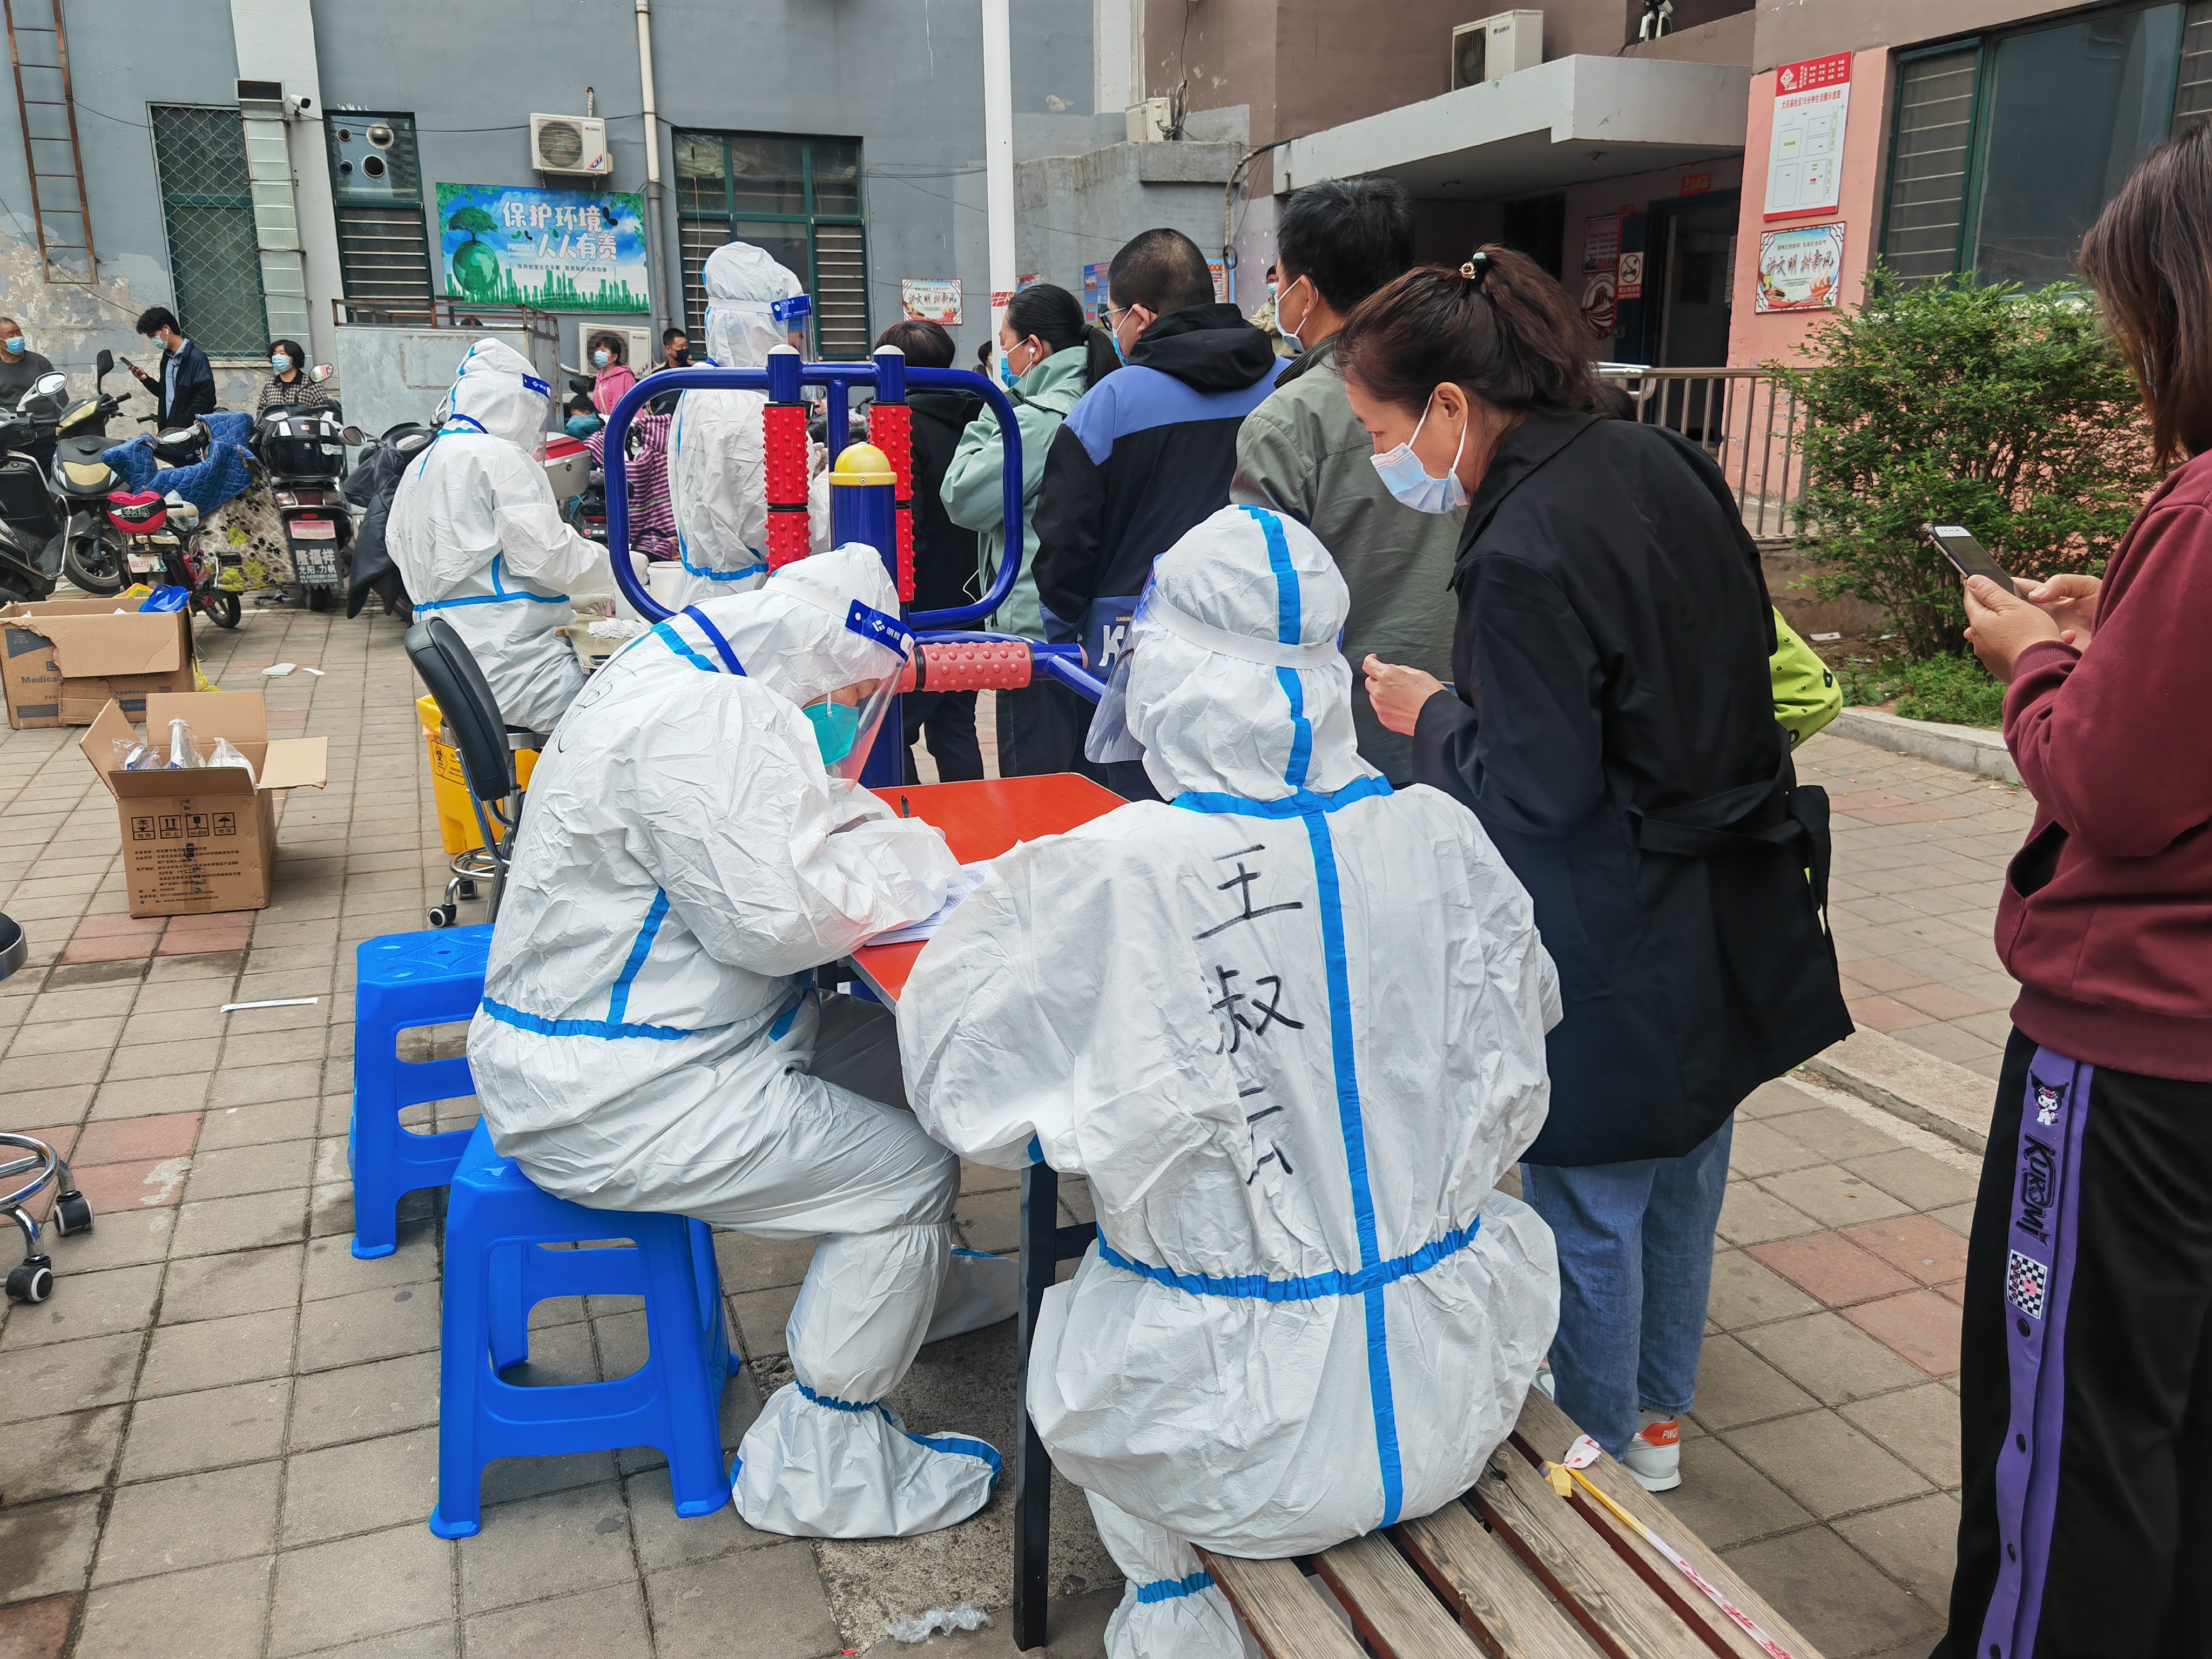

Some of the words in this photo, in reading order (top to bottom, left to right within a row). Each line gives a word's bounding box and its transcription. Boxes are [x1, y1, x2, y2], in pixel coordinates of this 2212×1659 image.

[502, 200, 602, 233] 保护环境
[538, 232, 617, 261] 人人有责
[121, 508, 150, 518] 爱玛
[295, 548, 335, 565] 隆福祥
[886, 626, 901, 642] 明辉
[21, 676, 59, 684] Medical
